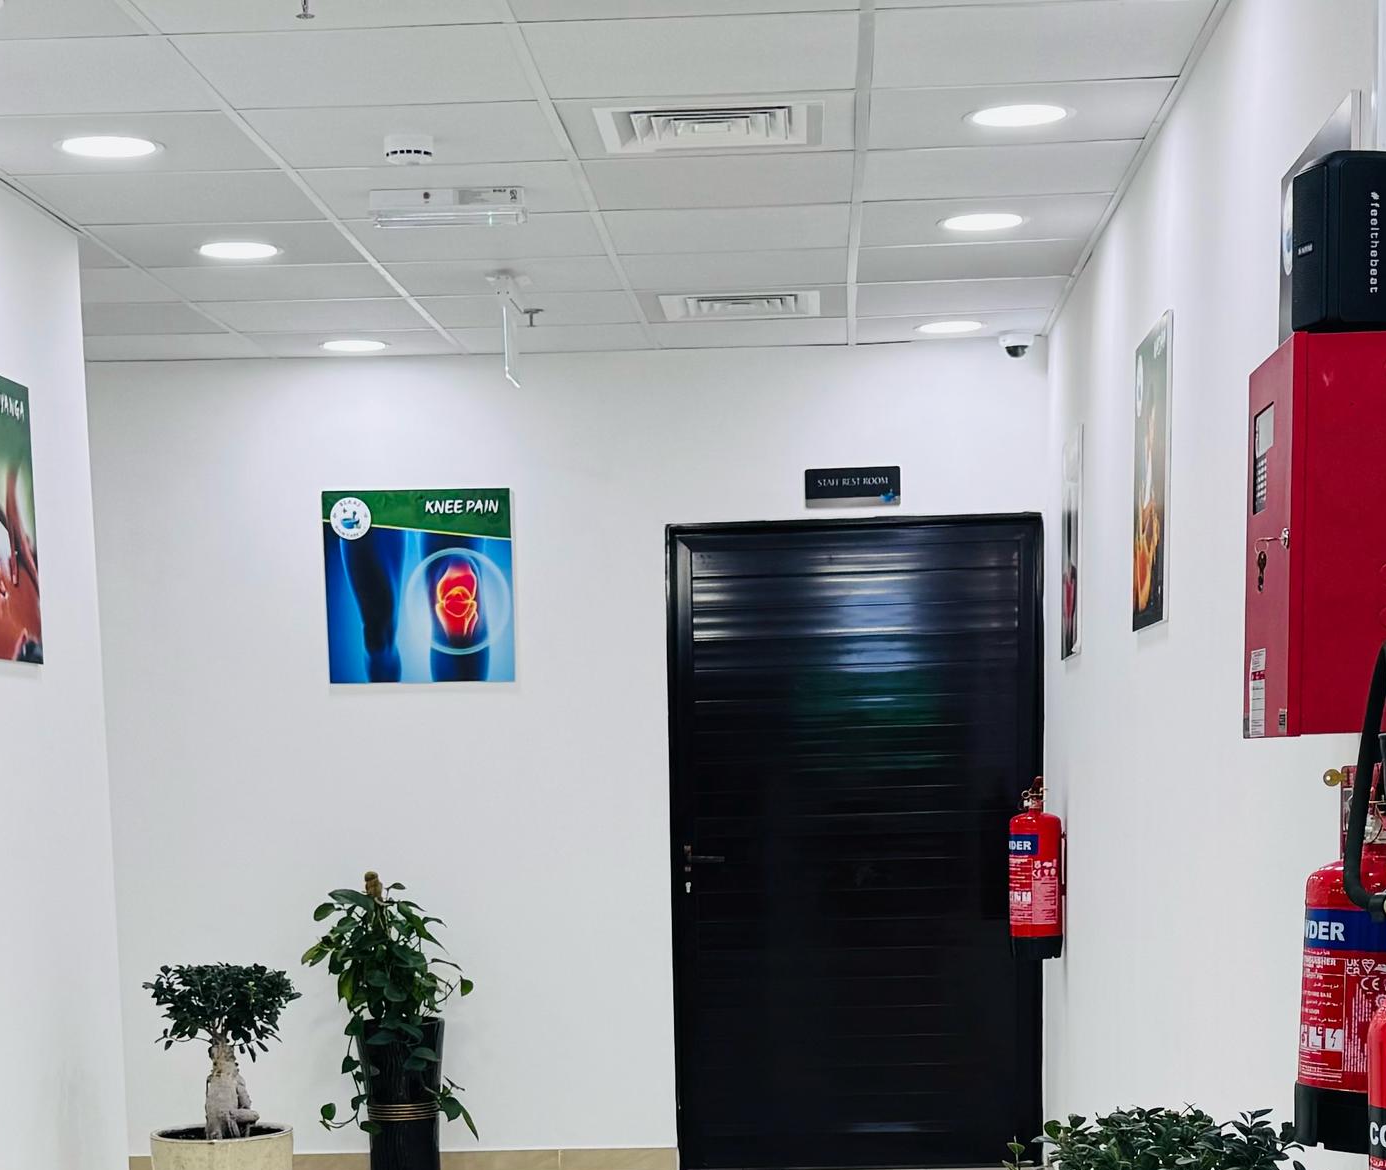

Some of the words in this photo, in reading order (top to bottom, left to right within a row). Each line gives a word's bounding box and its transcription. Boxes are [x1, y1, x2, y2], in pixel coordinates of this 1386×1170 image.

[1369, 191, 1380, 293] #feelthebeat
[817, 478, 839, 487] STAFF
[842, 477, 860, 486] REST
[862, 476, 889, 485] ROOM
[424, 499, 463, 514] KNEE
[465, 499, 499, 515] PAIN
